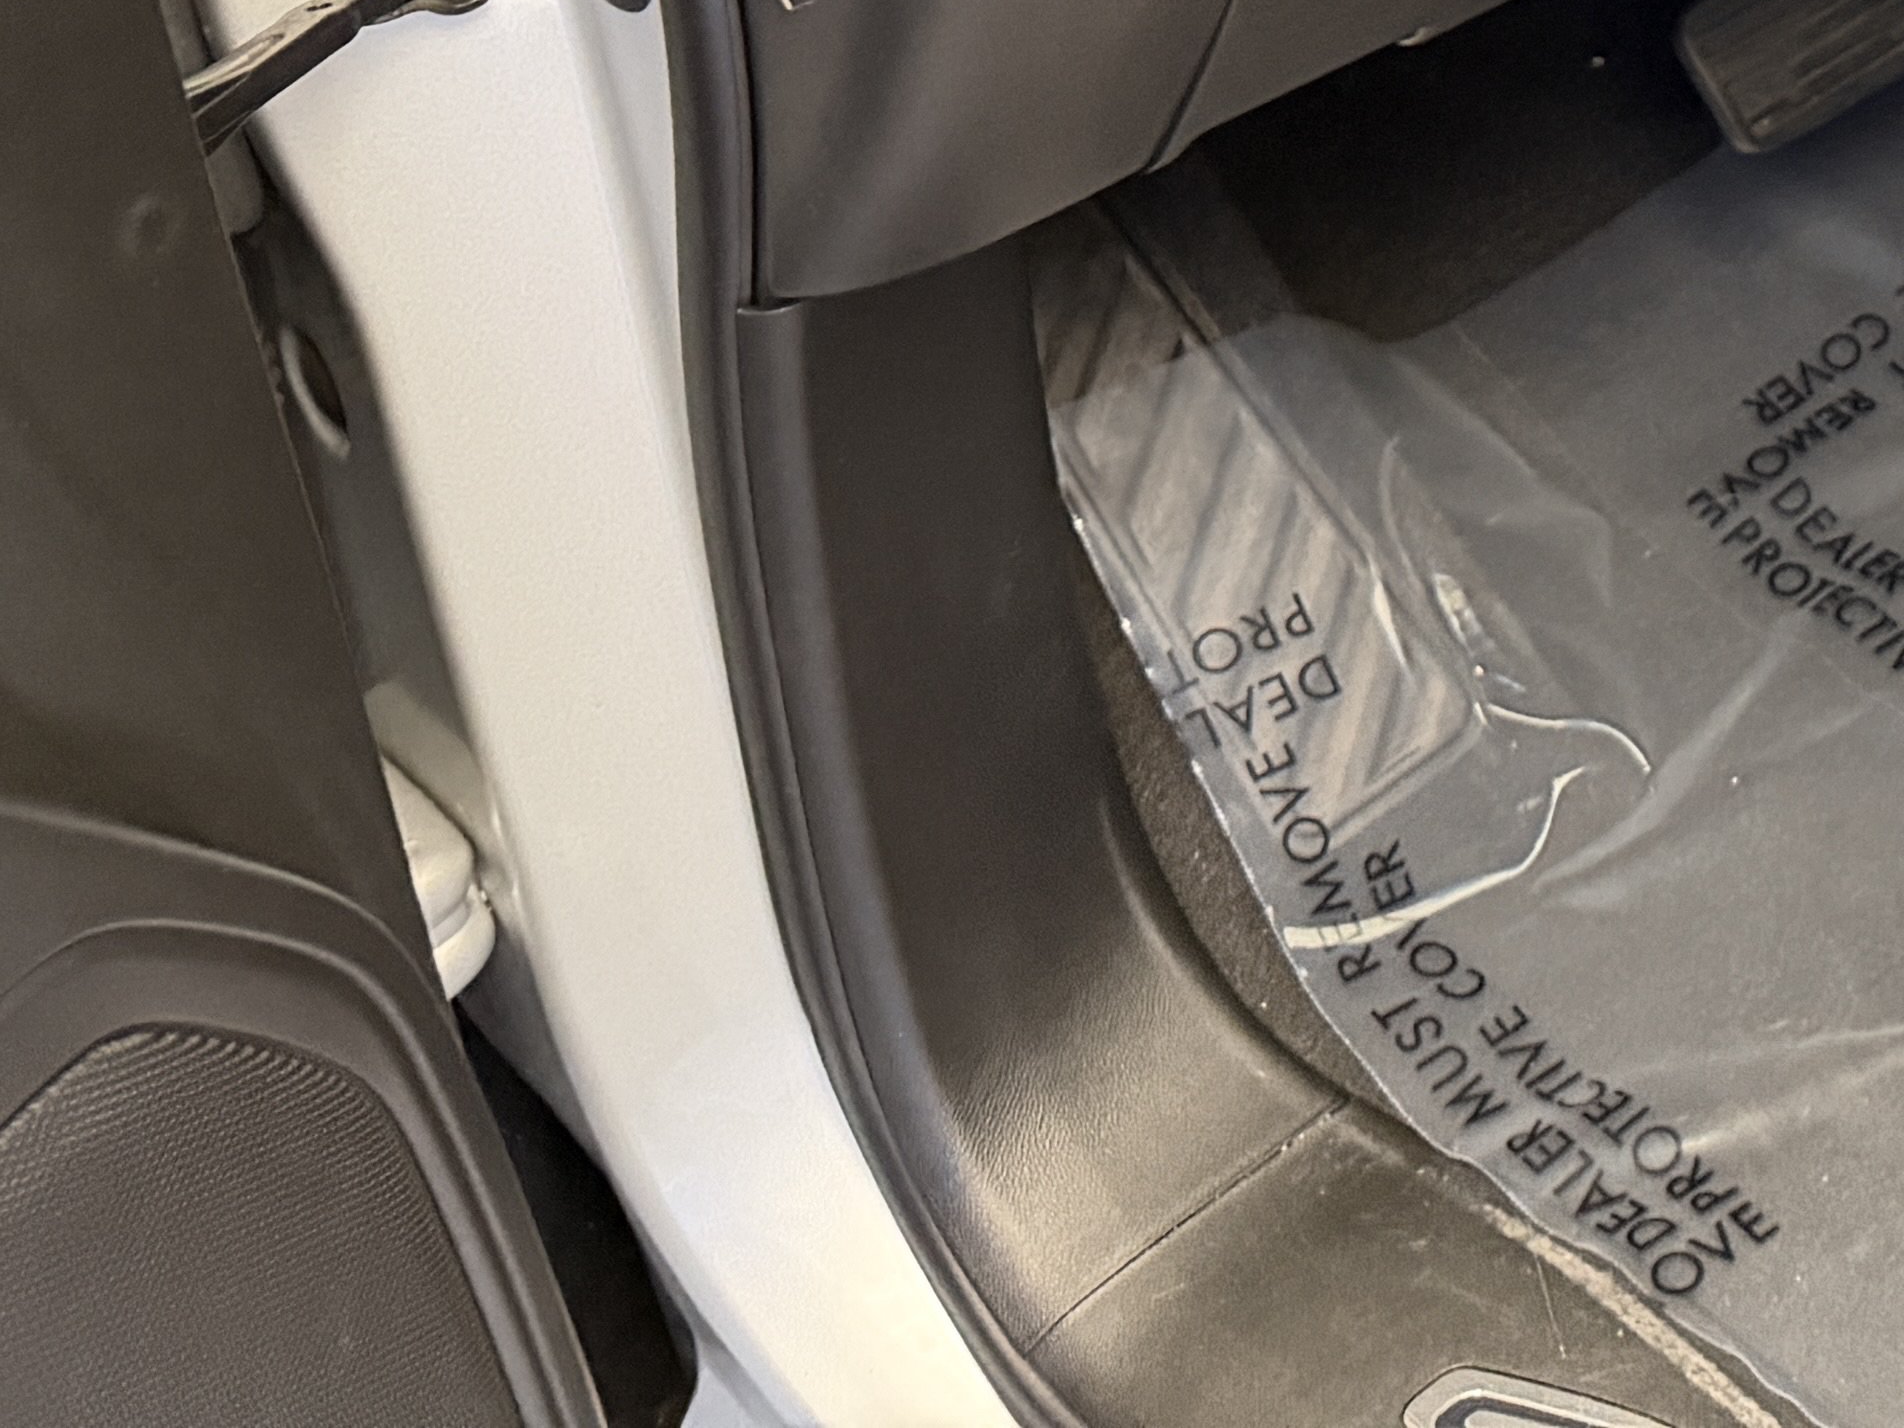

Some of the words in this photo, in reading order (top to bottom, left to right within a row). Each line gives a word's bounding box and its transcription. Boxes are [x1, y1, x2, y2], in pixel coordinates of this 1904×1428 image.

[1741, 312, 1892, 428] COVER
[1184, 653, 1342, 749] DEAL
[1371, 997, 1509, 1130] MUST
[1478, 1004, 1741, 1215] PROTECTIVE
[1506, 1119, 1678, 1253] DEALER
